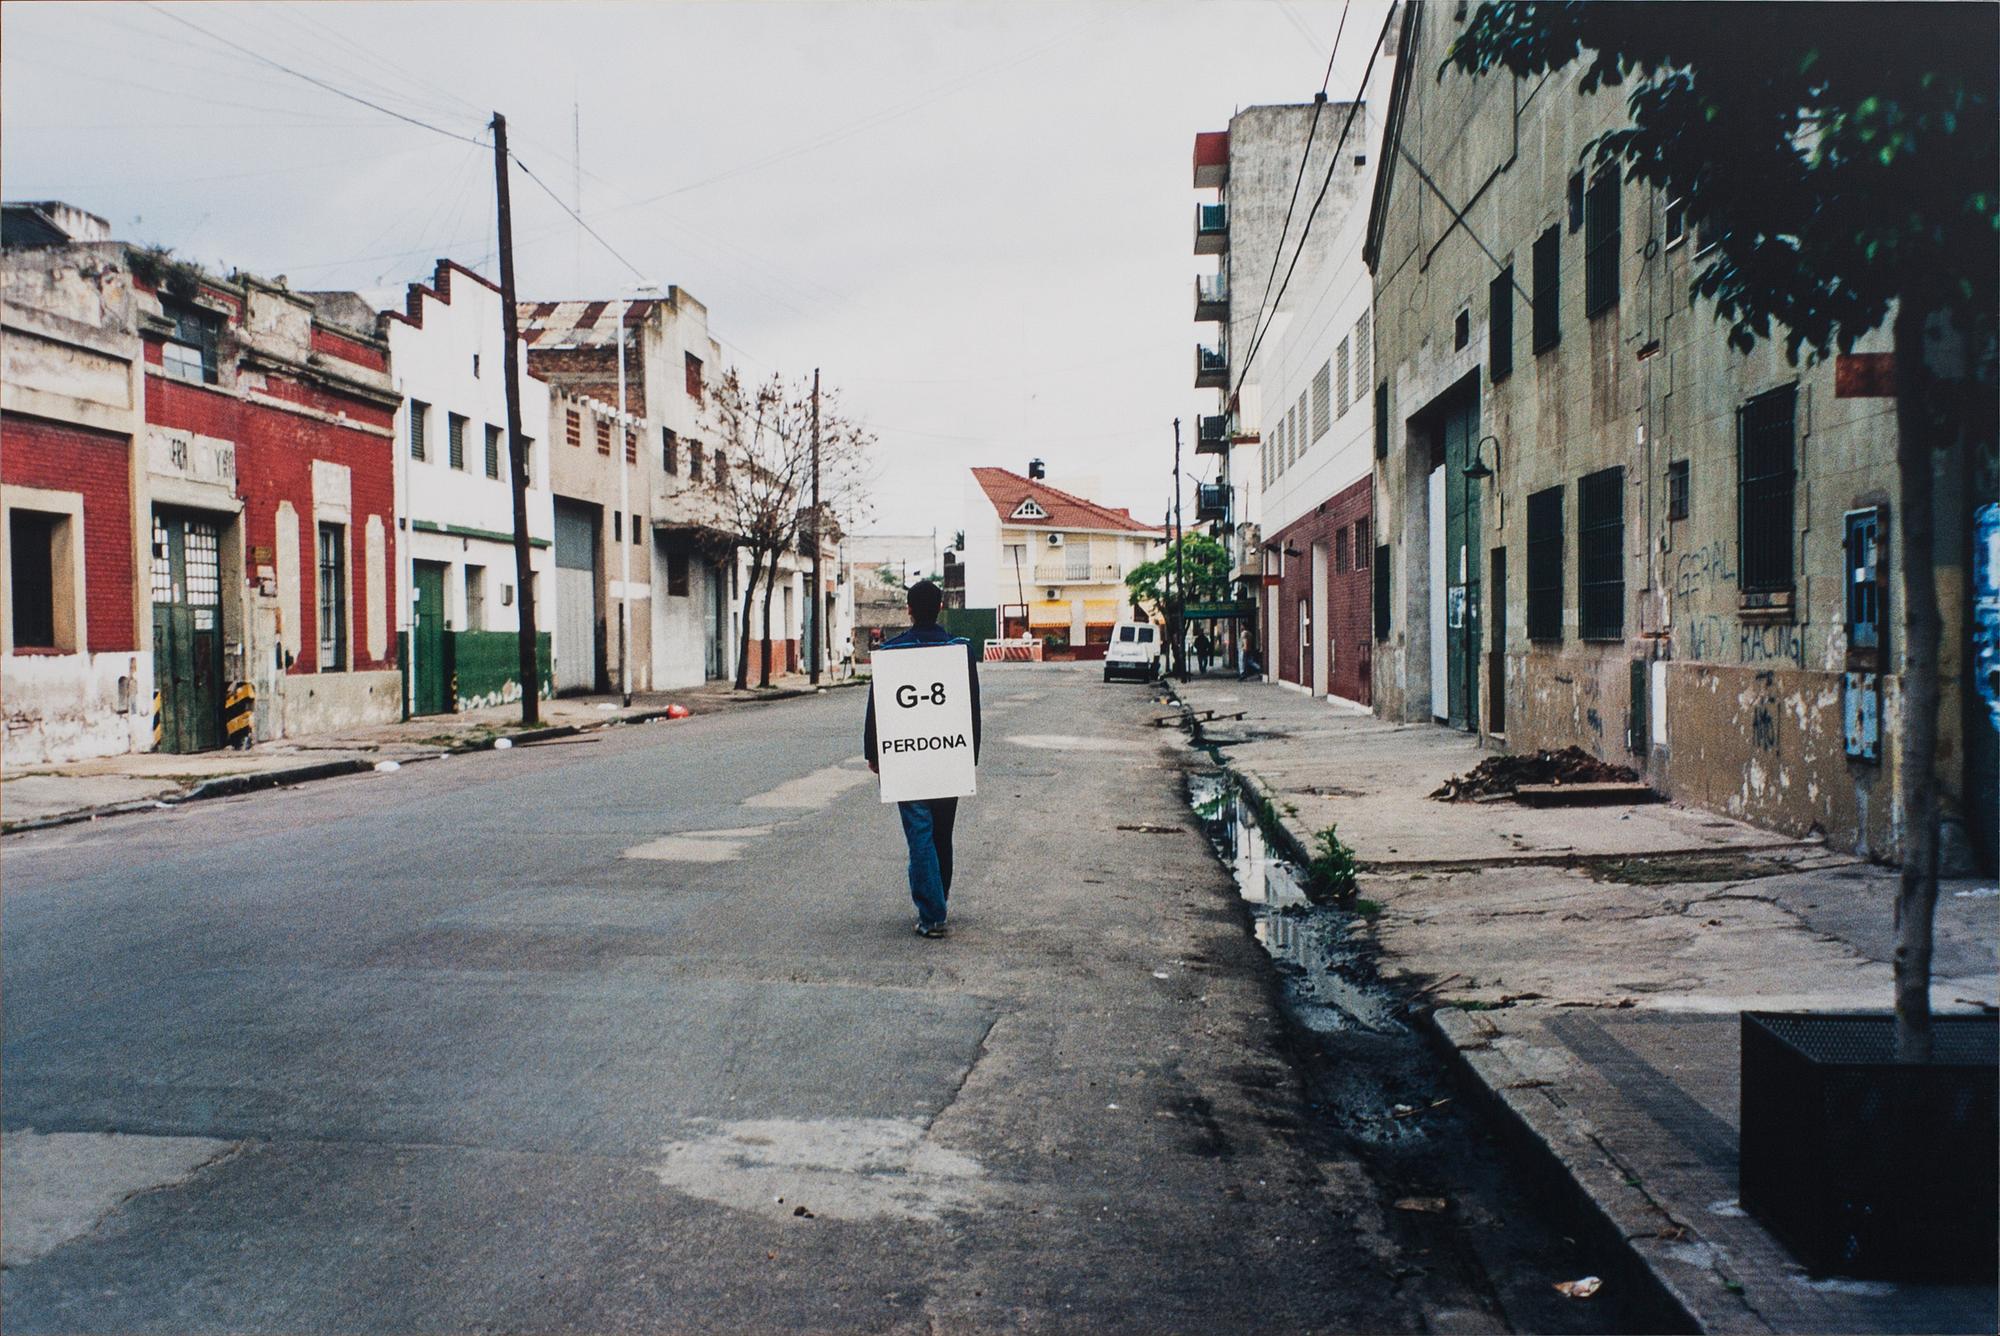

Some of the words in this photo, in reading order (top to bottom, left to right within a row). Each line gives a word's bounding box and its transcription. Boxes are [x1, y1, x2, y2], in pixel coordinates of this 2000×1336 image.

[1740, 623, 1800, 669] RACING
[895, 681, 947, 709] G-8
[881, 733, 967, 755] PERDONA
